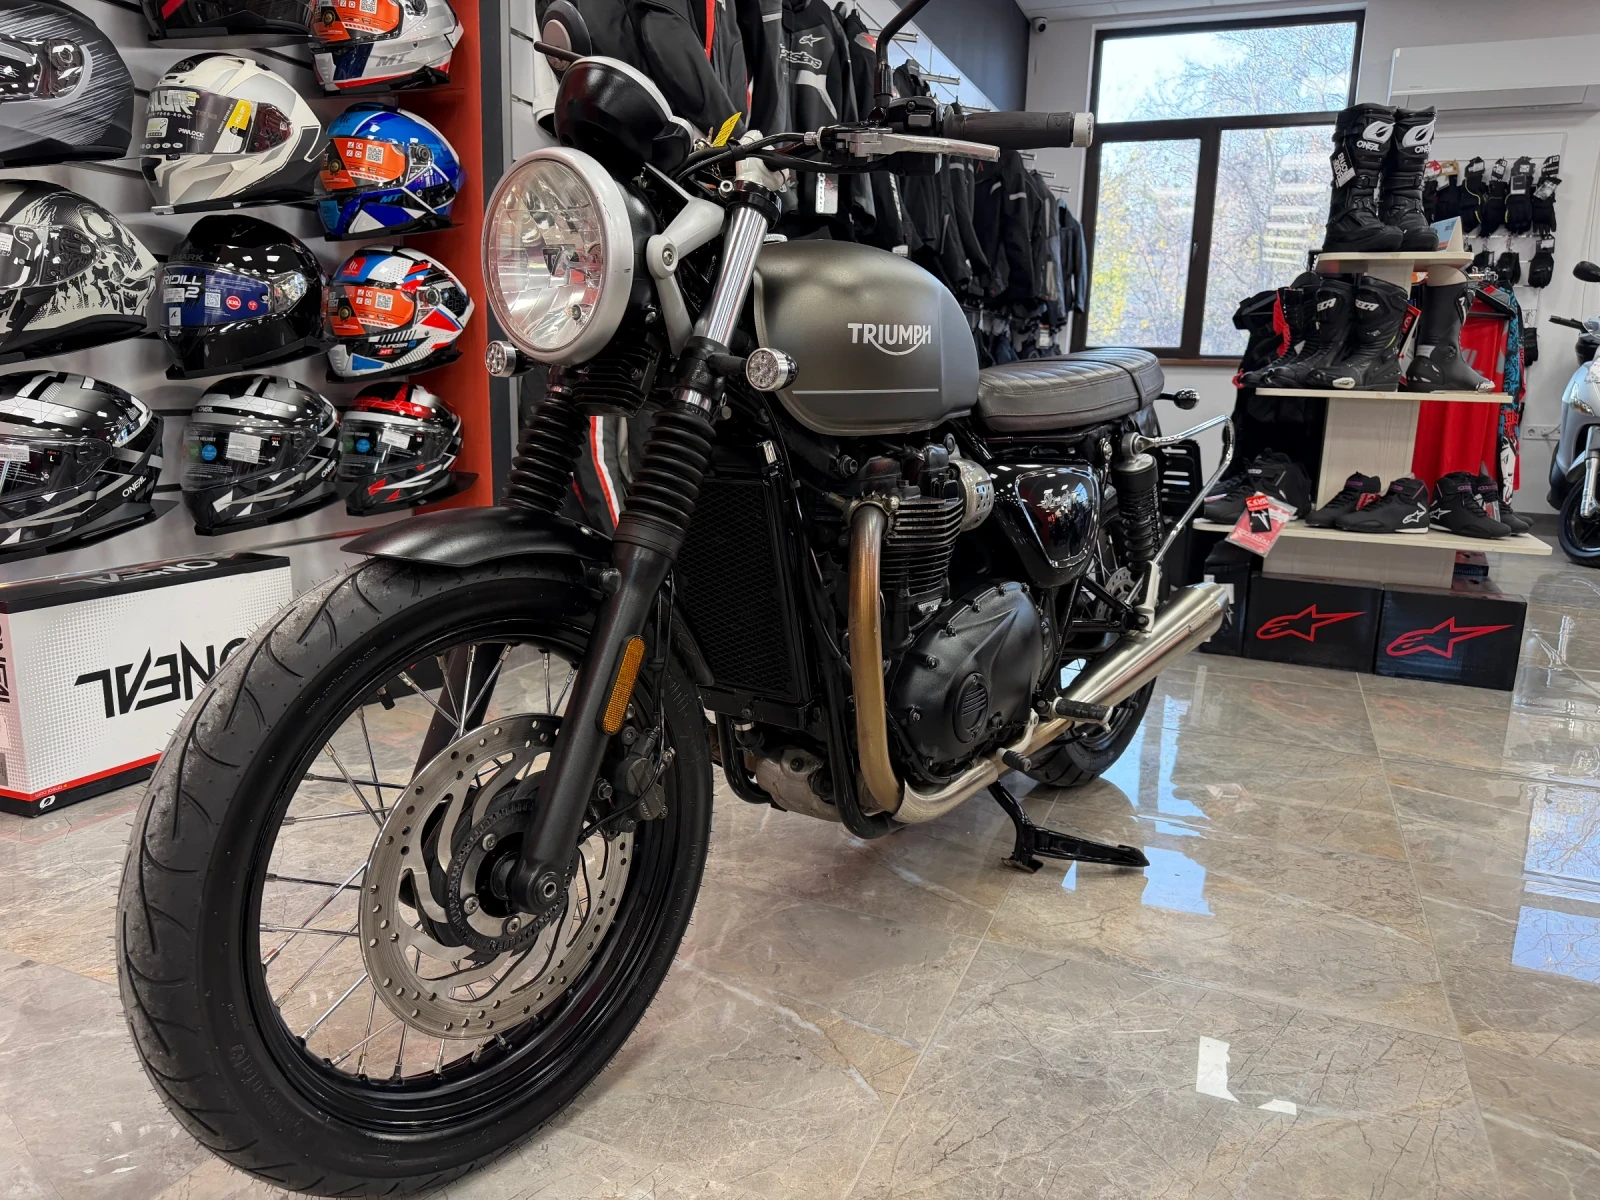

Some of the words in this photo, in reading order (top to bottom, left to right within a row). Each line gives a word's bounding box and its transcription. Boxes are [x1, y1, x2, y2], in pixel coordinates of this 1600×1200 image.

[375, 53, 409, 67] MT
[1356, 140, 1380, 151] ONEAL
[379, 194, 403, 203] MT
[163, 274, 202, 285] RIDILL
[185, 286, 200, 299] 2
[847, 322, 932, 355] TRIUMPH
[121, 475, 147, 498] ONEAL
